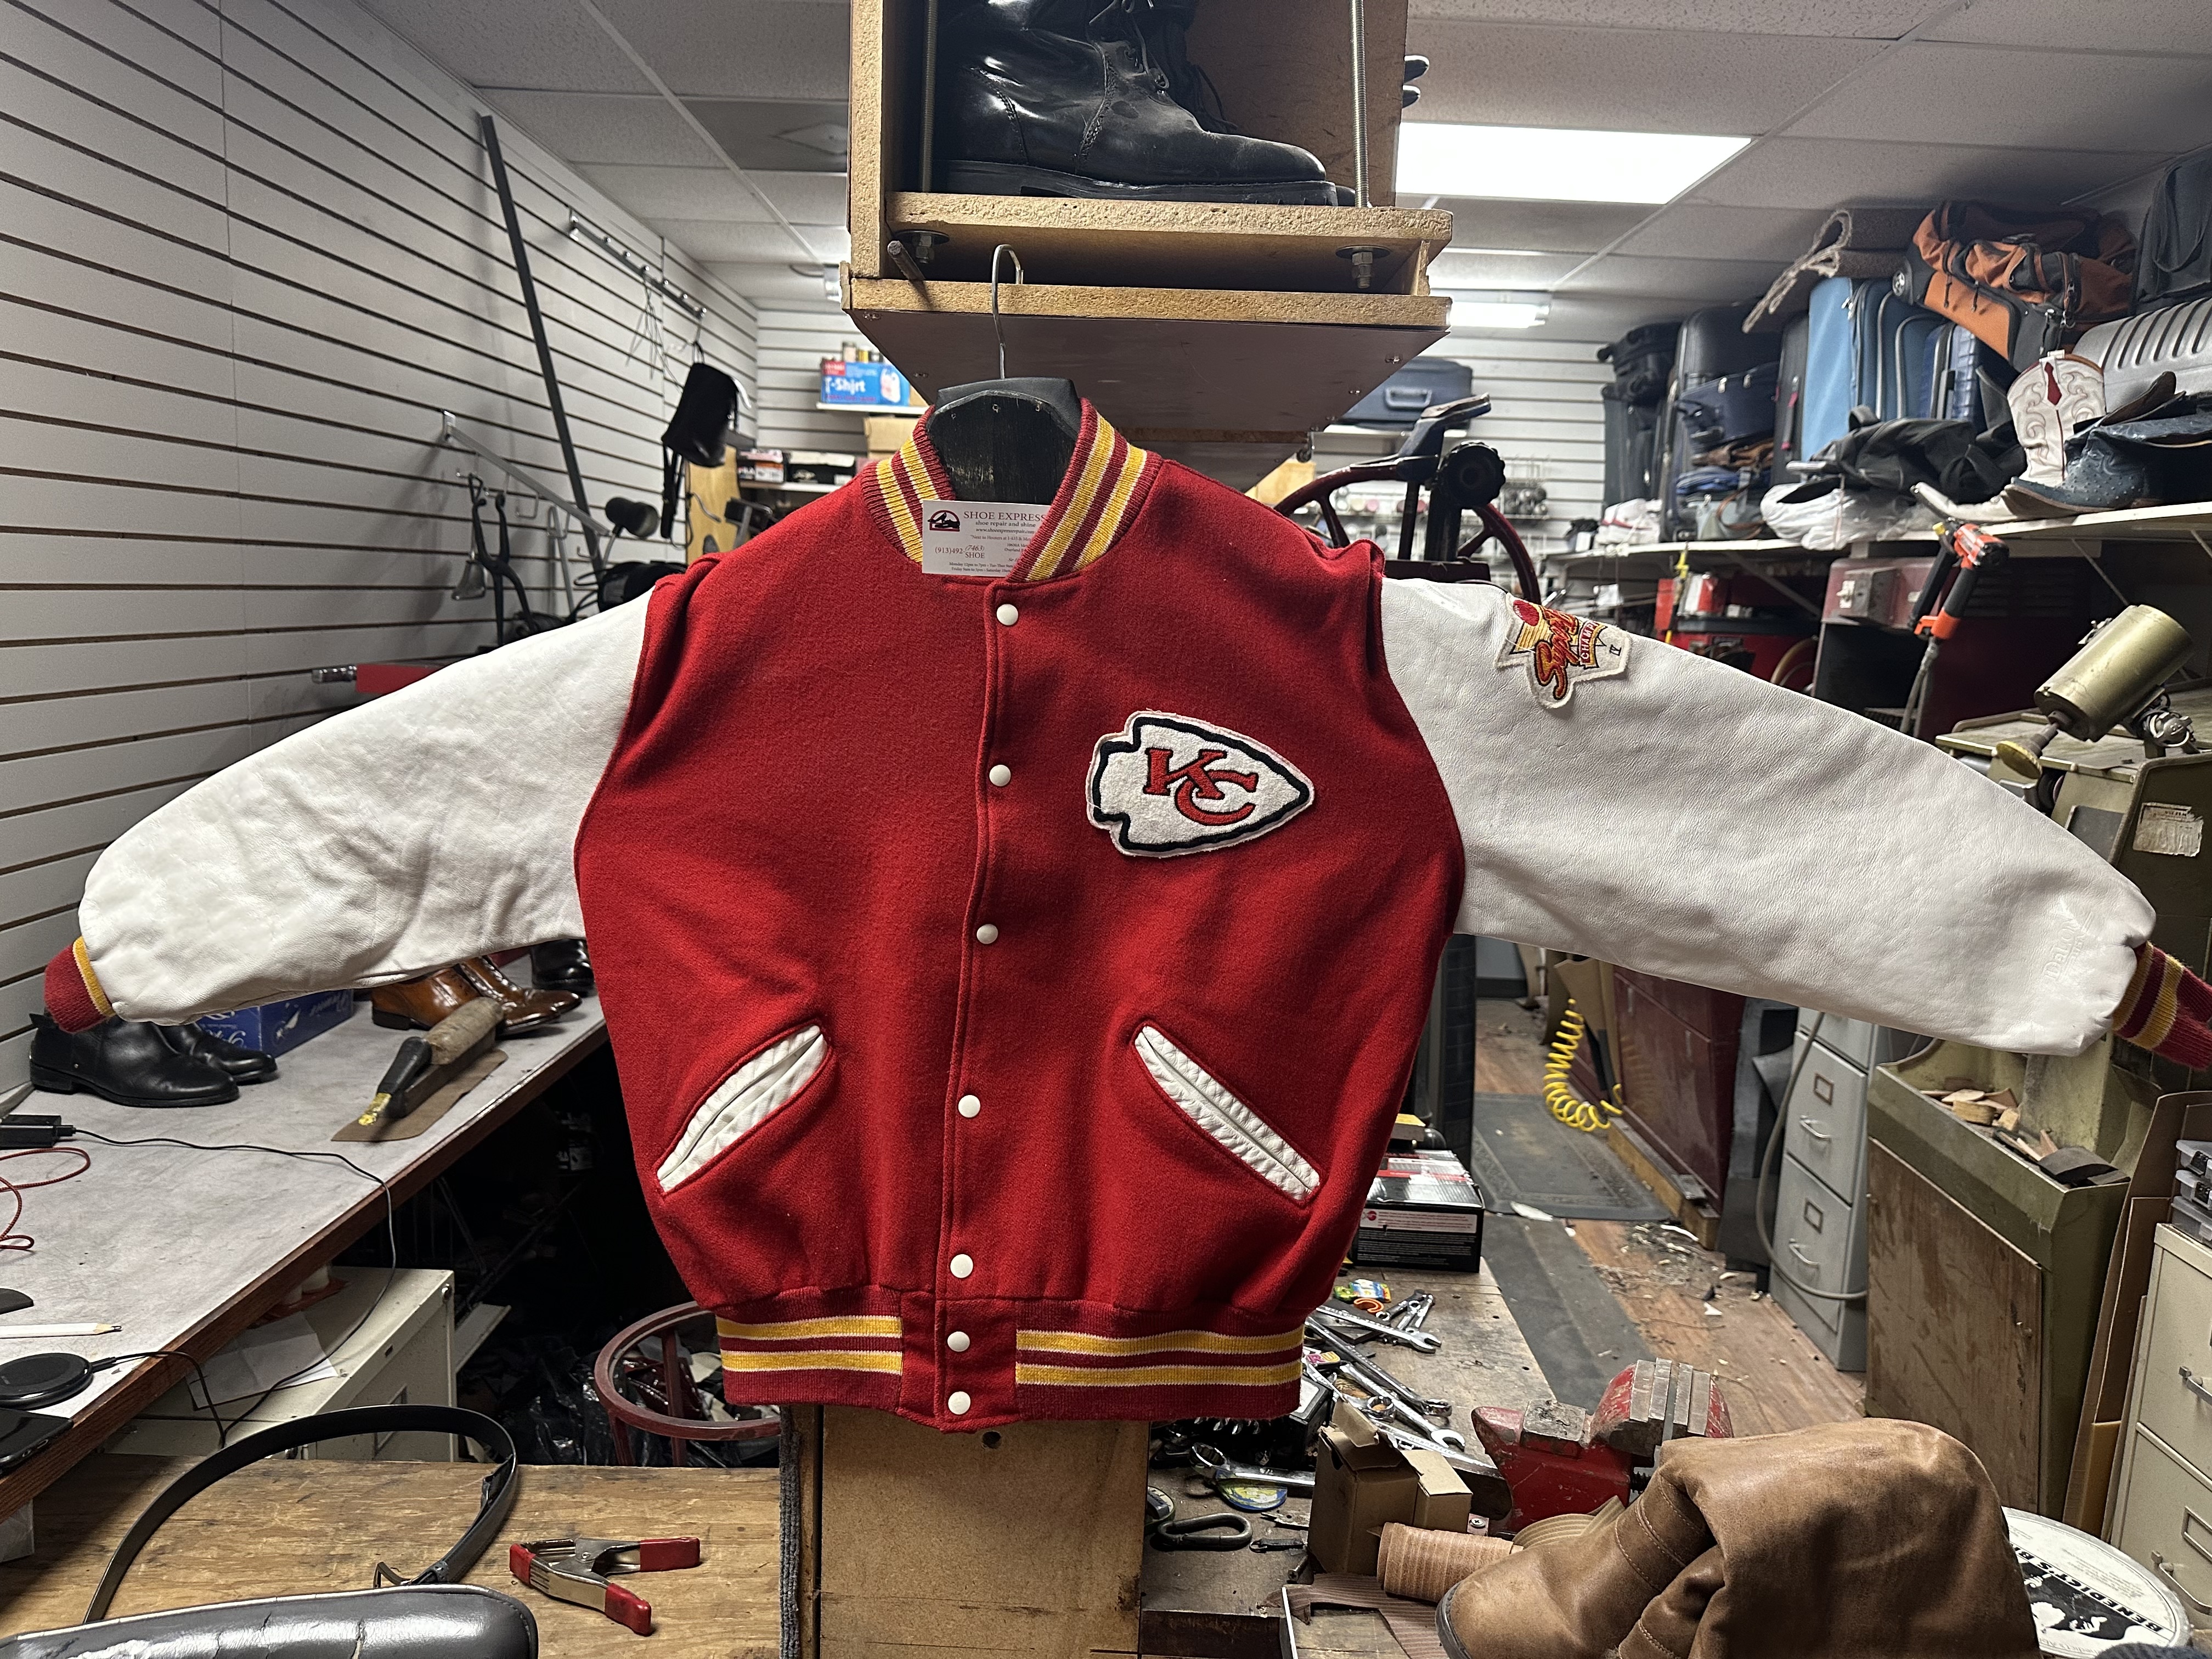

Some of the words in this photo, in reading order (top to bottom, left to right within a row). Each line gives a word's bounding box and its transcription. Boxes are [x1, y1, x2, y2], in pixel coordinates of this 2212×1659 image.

[963, 511, 995, 520] SHOE
[1609, 644, 1622, 657] IV
[1143, 747, 1260, 827] KC
[2036, 1561, 2164, 1632] BENEDICT'S
